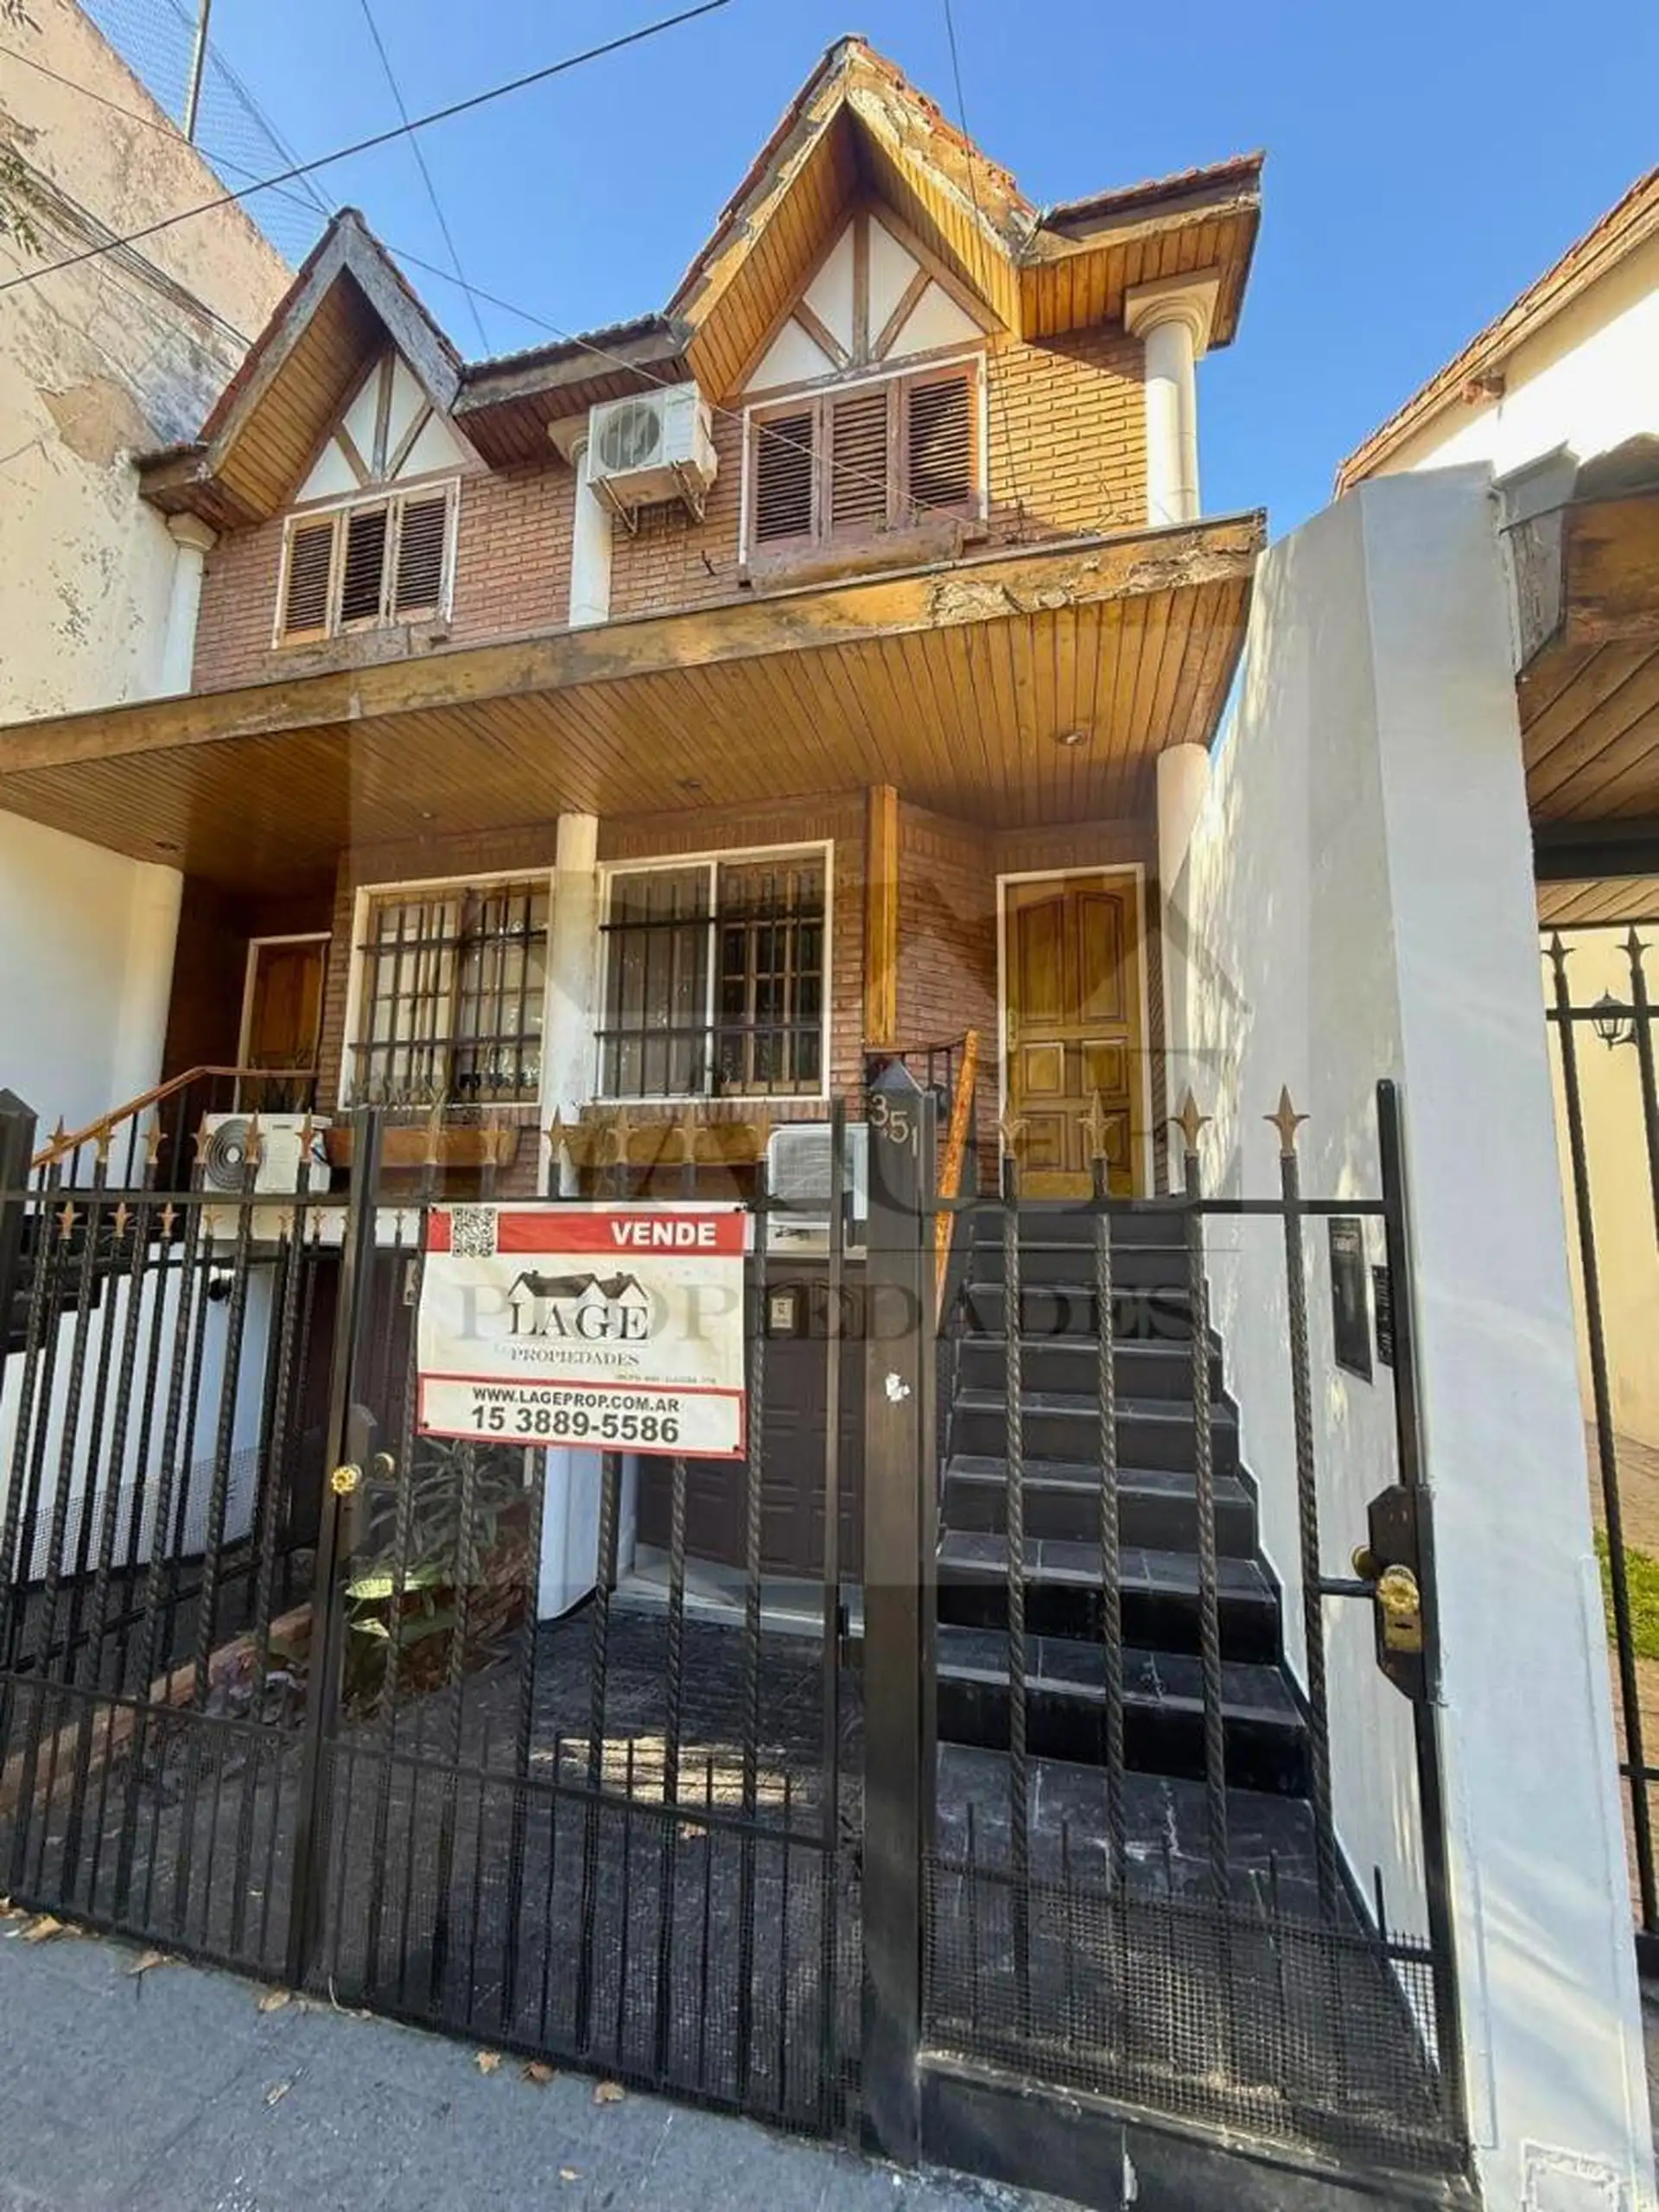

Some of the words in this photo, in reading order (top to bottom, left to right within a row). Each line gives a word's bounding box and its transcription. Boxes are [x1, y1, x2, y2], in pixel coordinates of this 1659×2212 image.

[870, 1094, 918, 1157] 351
[611, 1221, 717, 1247] VENDE
[506, 1300, 651, 1341] LAGE
[510, 1346, 640, 1367] PROPIEDADES
[472, 1386, 680, 1413] WWW.LAGEPROP.COM.AR
[471, 1406, 505, 1431] 15
[515, 1408, 680, 1443] 3889-5586
